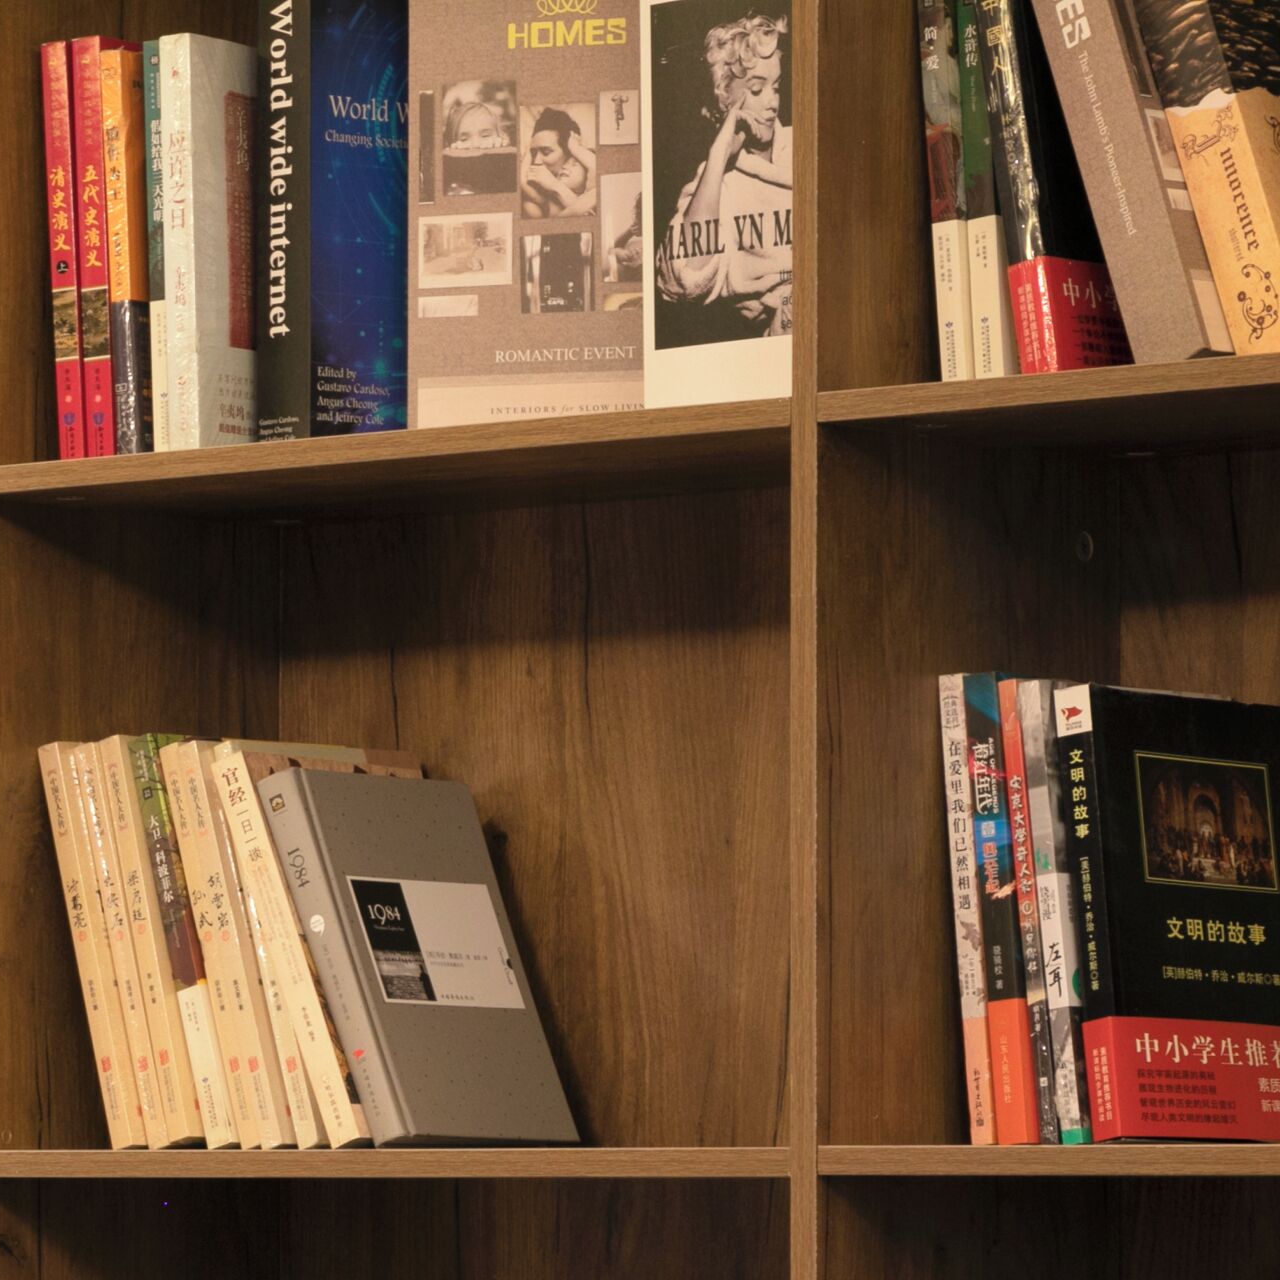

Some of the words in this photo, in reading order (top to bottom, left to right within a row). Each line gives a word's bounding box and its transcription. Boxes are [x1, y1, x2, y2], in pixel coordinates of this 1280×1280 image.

[508, 17, 627, 49] HOMES
[1078, 51, 1089, 71] The
[1084, 74, 1096, 93] John
[329, 95, 389, 123] World
[325, 129, 373, 148] Changing
[269, 130, 293, 199] wide
[48, 165, 71, 254] 清史演义
[269, 204, 293, 338] internet
[495, 347, 581, 364] ROMANTIC
[583, 345, 637, 362] EVENT
[316, 366, 344, 380] Edited
[345, 367, 358, 383] by
[317, 380, 354, 395] Gustavo
[316, 396, 347, 412] Angus
[349, 398, 379, 414] Cheong
[316, 410, 335, 423] and
[335, 411, 364, 427] Jeffrey
[365, 413, 385, 426] Cole
[490, 405, 557, 416] INTERIORS
[578, 403, 609, 413] SLOW
[1068, 748, 1090, 840] 文明的故事
[286, 847, 310, 890] 1984
[367, 902, 402, 926] 1984
[1166, 916, 1268, 945] 文明的故事
